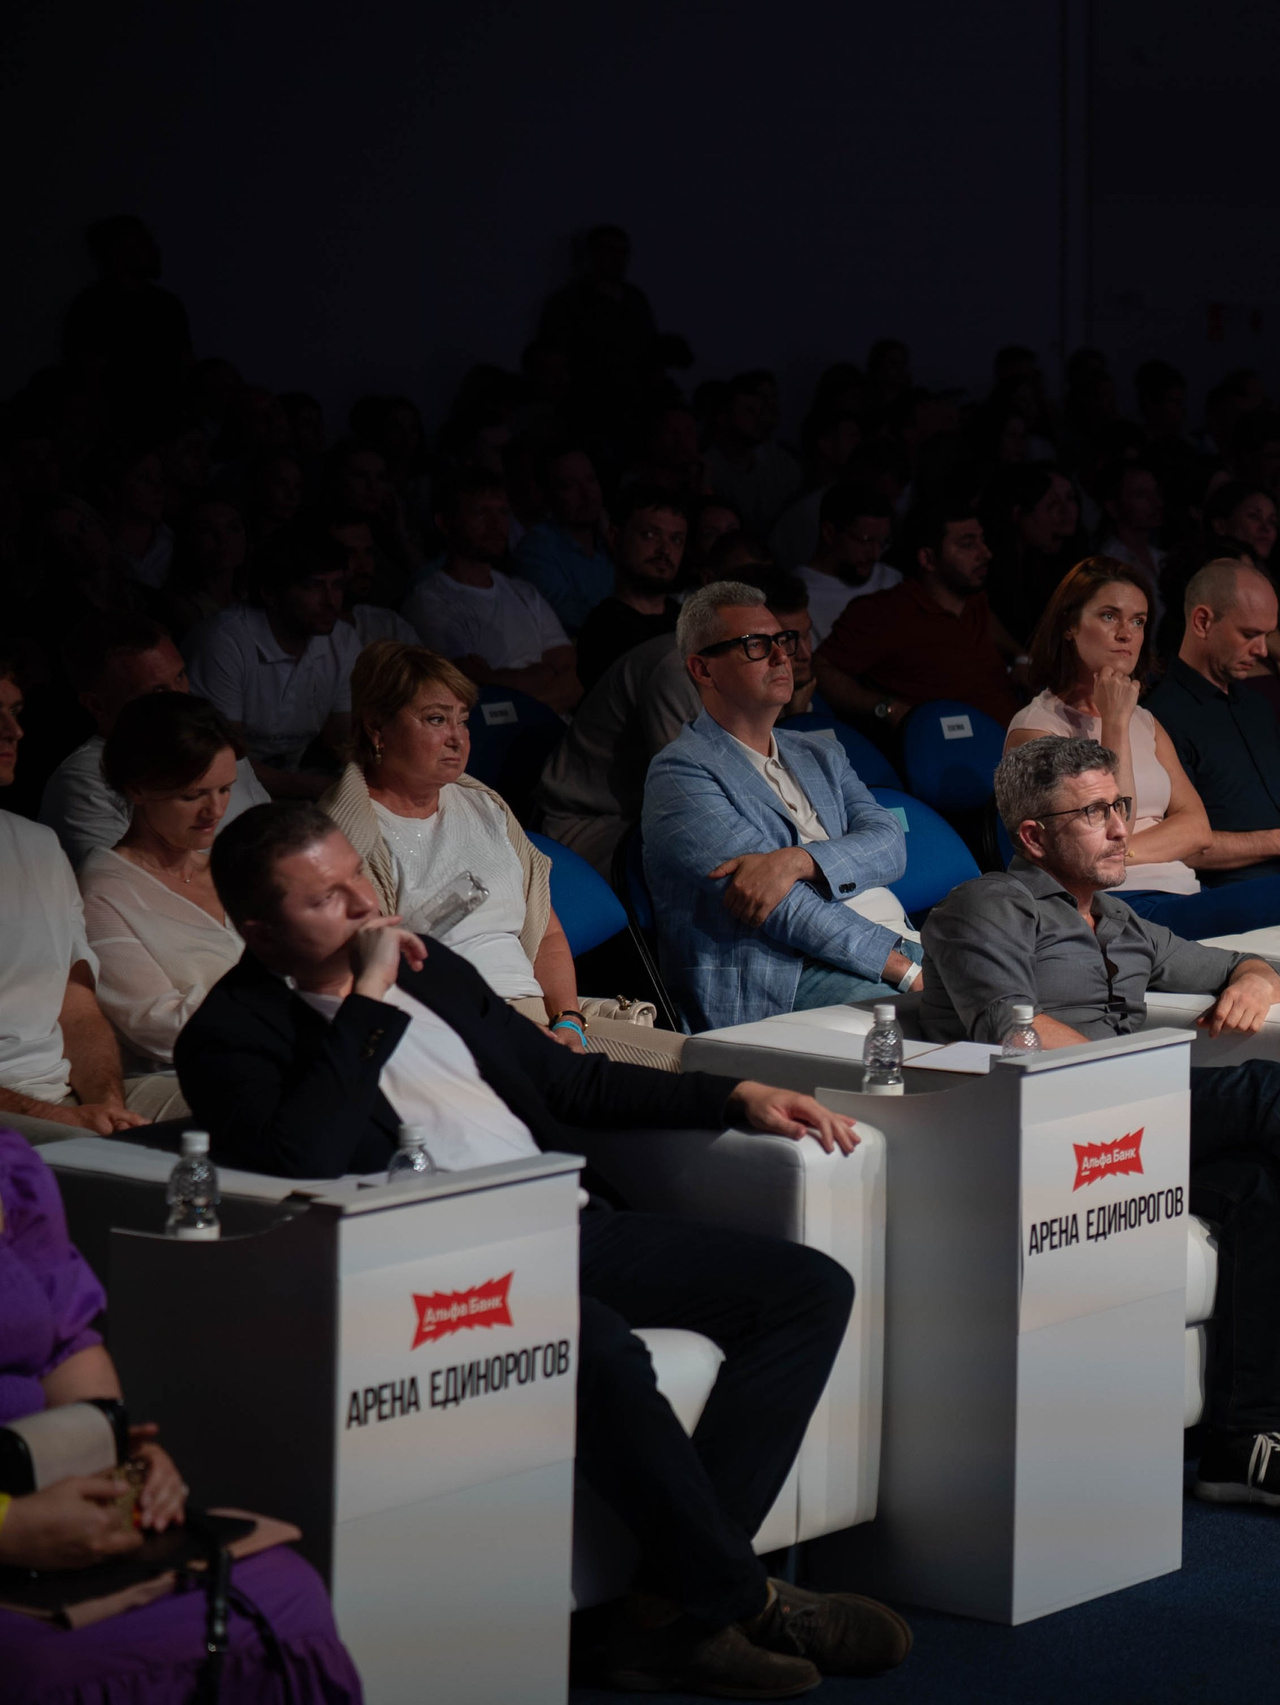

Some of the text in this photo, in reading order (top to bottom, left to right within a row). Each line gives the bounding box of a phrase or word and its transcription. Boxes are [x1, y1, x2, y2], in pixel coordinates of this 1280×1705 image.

[1082, 1148, 1137, 1169] Альфа Банк
[1028, 1186, 1184, 1257] АРЕНА ЕДИНОРОГОВ
[423, 1295, 504, 1325] Альфа Банк
[346, 1339, 571, 1430] АРЕНА ЕДИНОРОГОВ
